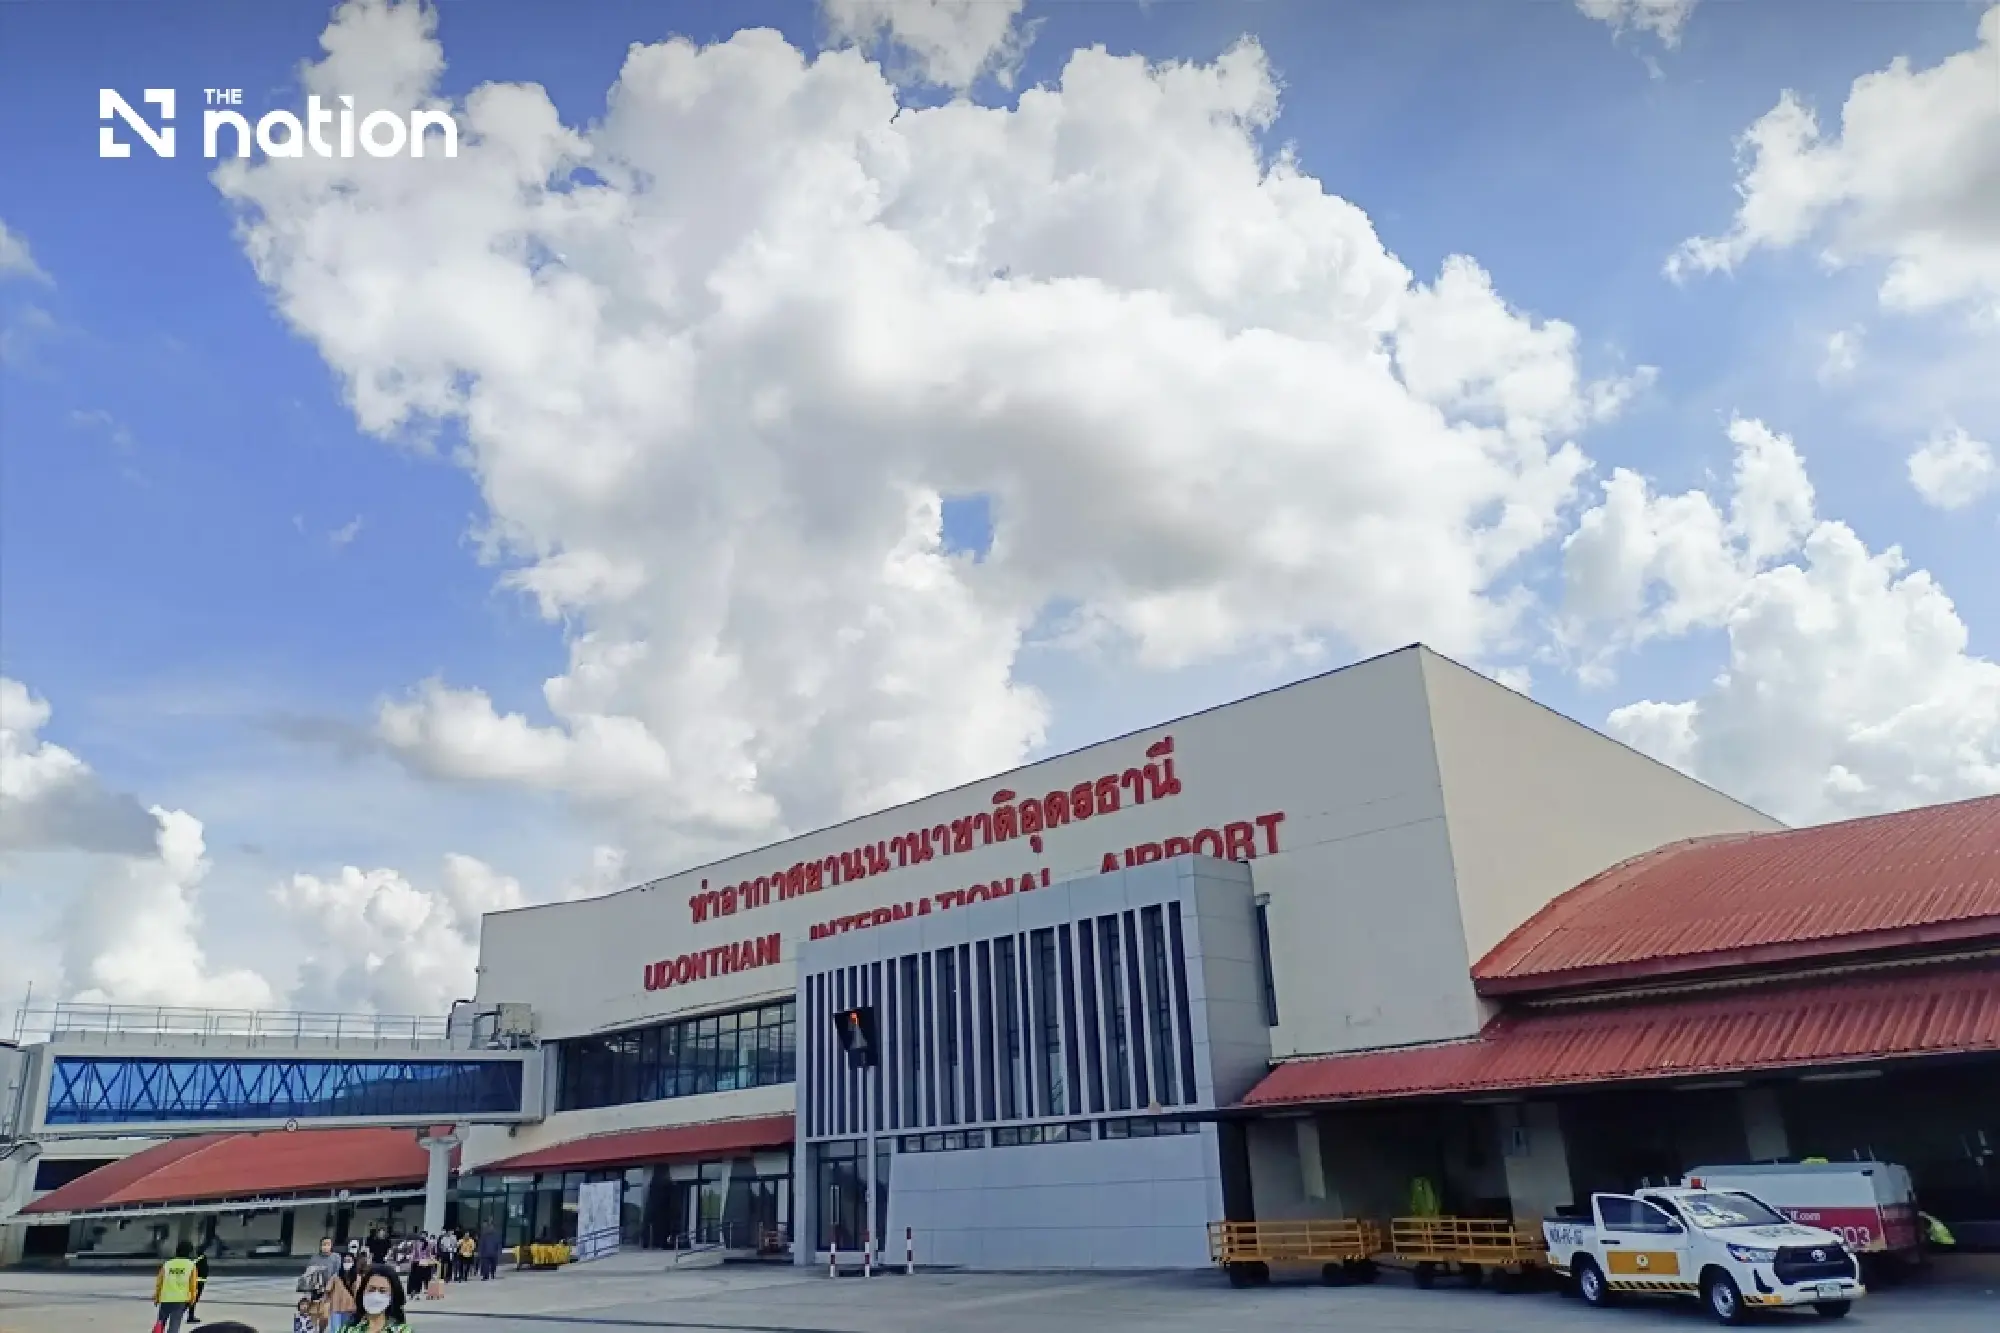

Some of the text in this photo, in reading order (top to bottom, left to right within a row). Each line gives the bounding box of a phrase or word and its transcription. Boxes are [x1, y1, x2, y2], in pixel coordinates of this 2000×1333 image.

[689, 735, 1182, 923] ท่าอากาศยานนานาชาติอุดรธานี
[644, 932, 780, 992] UDONTHANI
